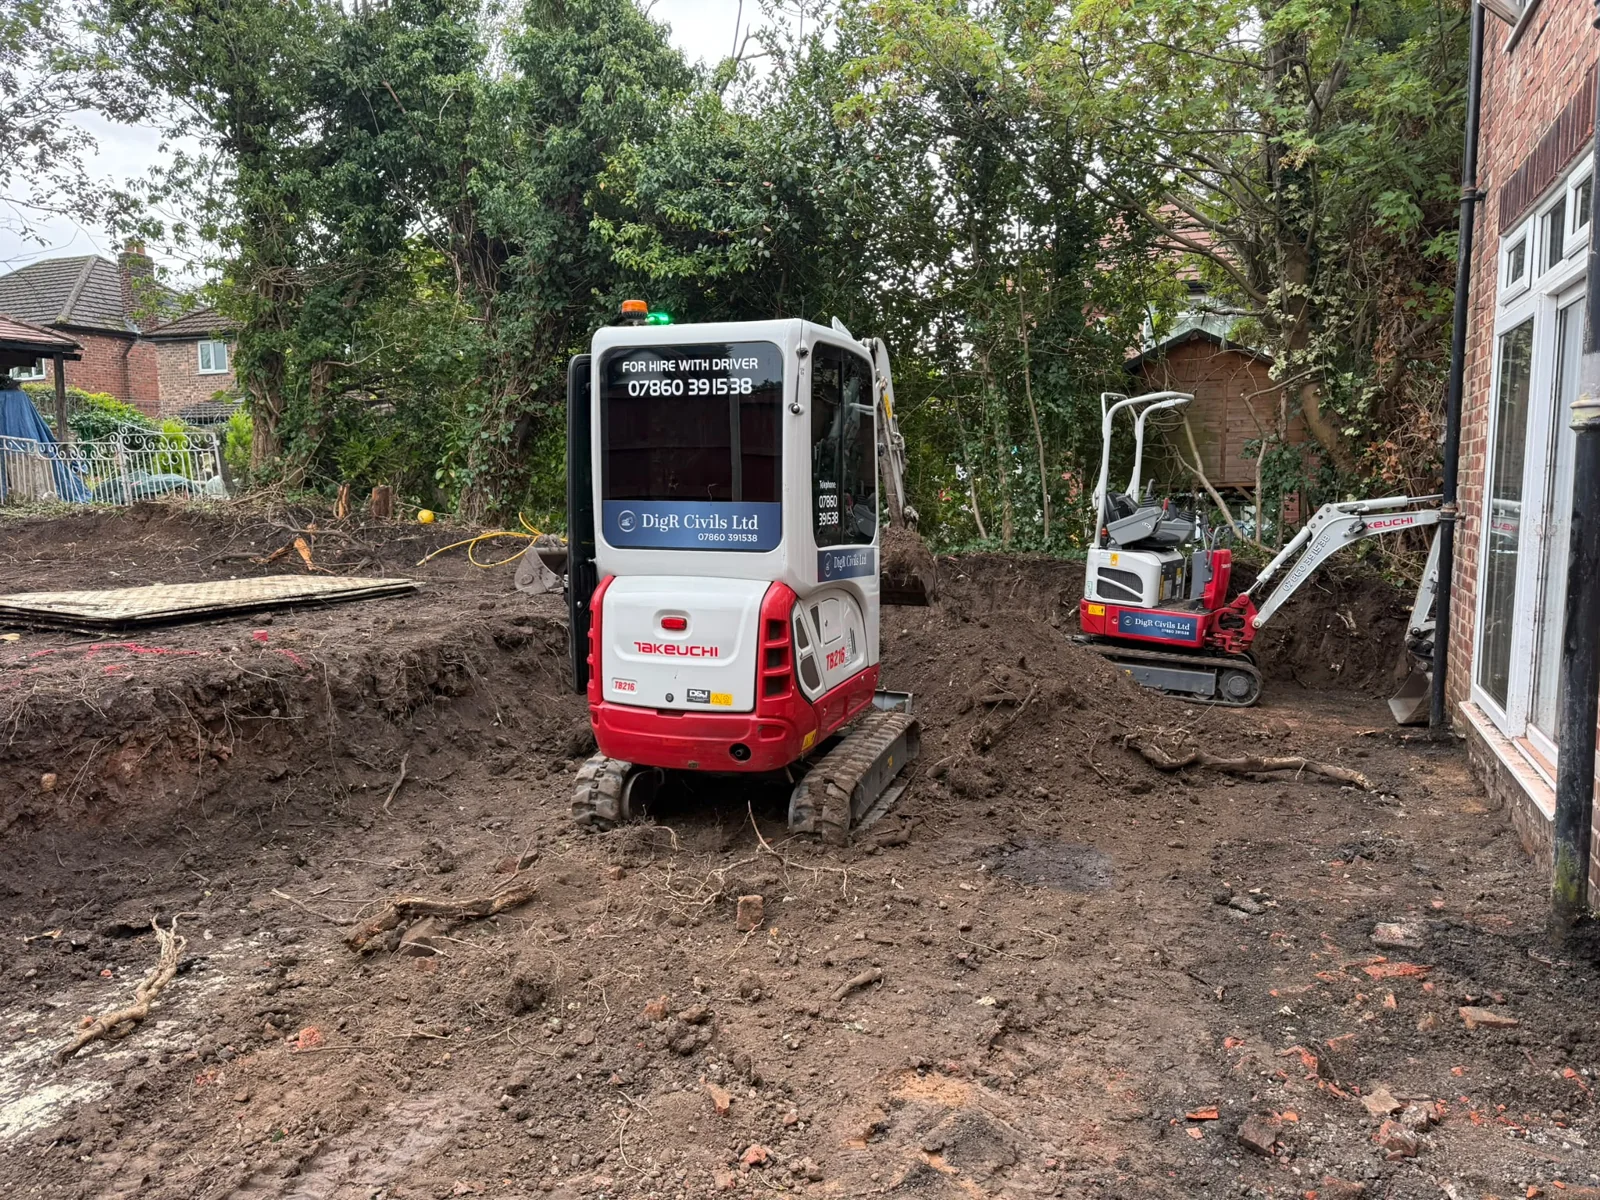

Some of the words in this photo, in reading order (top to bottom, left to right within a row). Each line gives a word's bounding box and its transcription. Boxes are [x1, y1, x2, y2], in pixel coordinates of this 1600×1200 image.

[622, 361, 646, 373] FOR
[649, 360, 676, 372] HIRE
[678, 359, 709, 371] WITH
[712, 357, 759, 370] DRIVER
[628, 379, 684, 397] 07860
[688, 377, 753, 396] 391538
[818, 495, 838, 508] 07860
[641, 513, 680, 532] DigR
[683, 513, 728, 529] Civils
[731, 514, 759, 530] Ltd
[818, 511, 839, 526] 391538
[1365, 516, 1413, 529] KEUCHI
[698, 533, 726, 542] 07860
[727, 533, 758, 543] 391538
[1135, 618, 1153, 627] DigR
[1154, 620, 1175, 629] Civils
[1177, 623, 1190, 631] Ltd
[634, 641, 719, 657] TAKEUCHI
[826, 646, 845, 671] TB216
[614, 680, 635, 691] TB216
